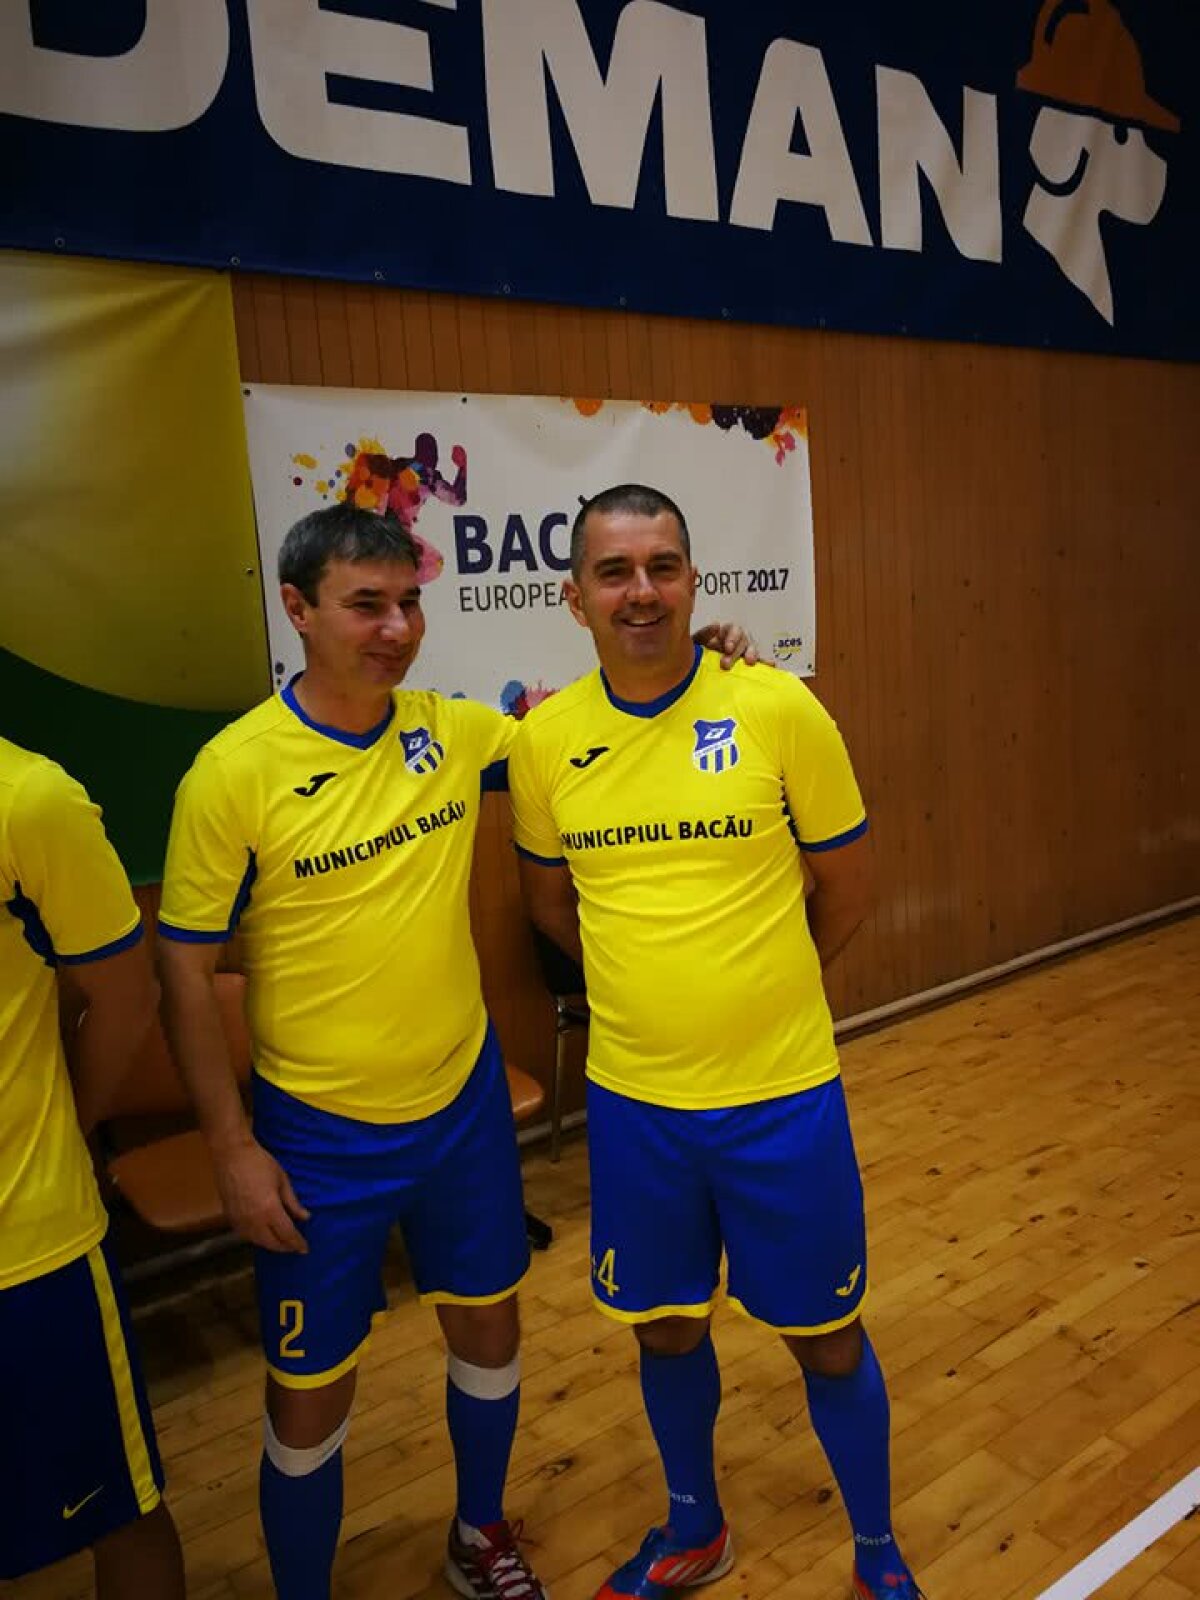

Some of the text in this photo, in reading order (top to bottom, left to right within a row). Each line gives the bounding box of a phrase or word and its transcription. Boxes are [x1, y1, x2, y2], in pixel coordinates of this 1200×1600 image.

[453, 512, 574, 574] BAC
[459, 568, 789, 612] EUROPE PORT 2017
[294, 800, 466, 879] MUNICIPIUL BACĂU
[678, 815, 752, 840] BACĂU
[592, 1247, 620, 1297] 4
[279, 1300, 305, 1358] 2
